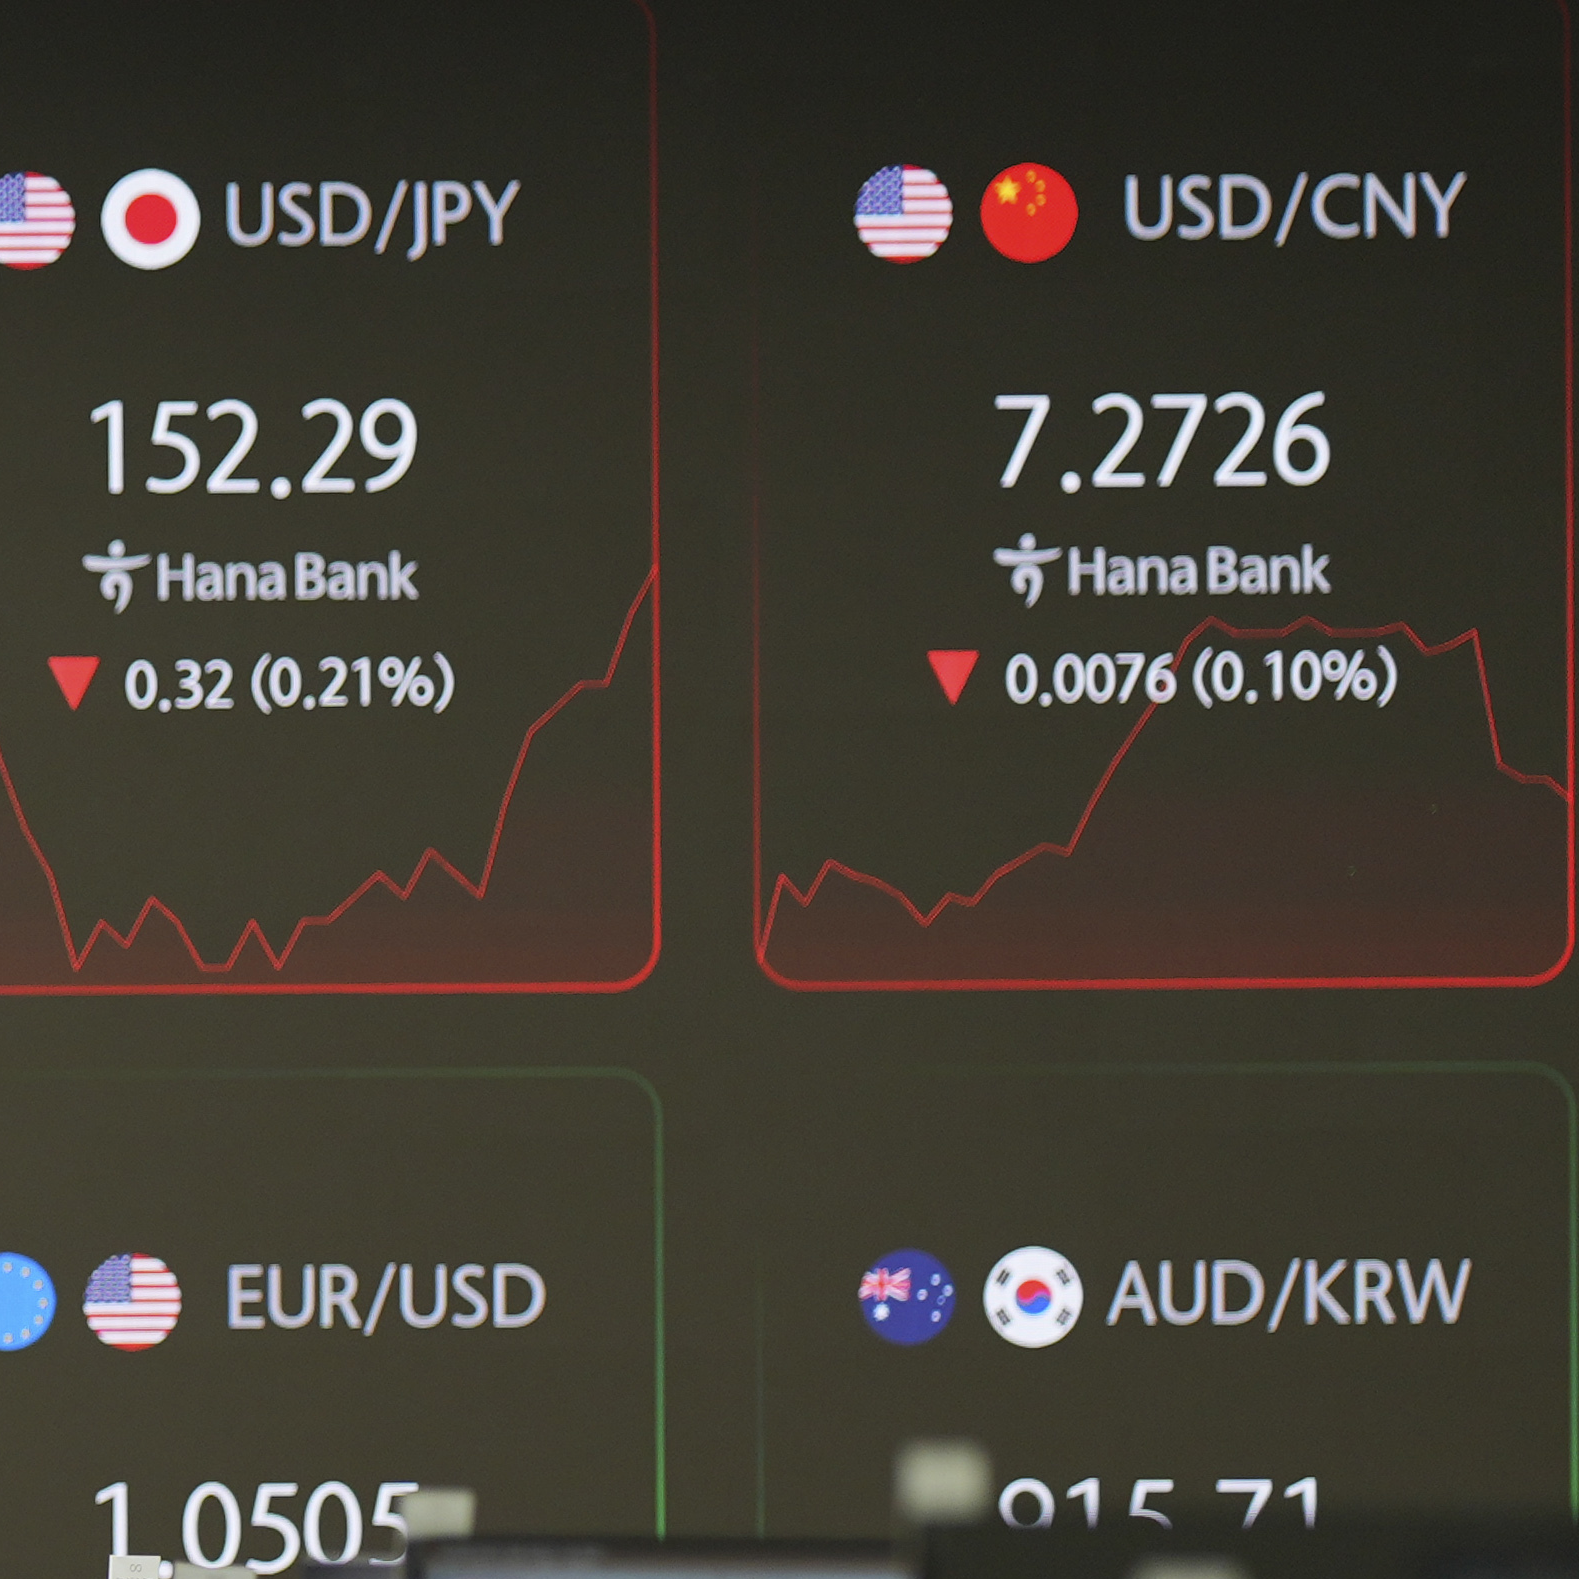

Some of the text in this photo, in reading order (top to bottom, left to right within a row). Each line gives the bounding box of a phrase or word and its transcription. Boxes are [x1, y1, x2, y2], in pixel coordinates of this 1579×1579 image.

[226, 179, 525, 262] USD/JPY
[1125, 170, 1470, 248] USD/CNY
[89, 397, 419, 502] 152.29
[994, 390, 1333, 496] 7.2726
[156, 547, 421, 604] Hana Bank
[1067, 542, 1334, 598] Hana Bank
[123, 650, 456, 716] 0.32 (0.21%)
[1004, 644, 1400, 711] 0.0076 (0.10%)
[228, 1260, 546, 1337] EUR/USD
[1105, 1256, 1474, 1333] AUD/KRW
[998, 1476, 1318, 1530] 91571
